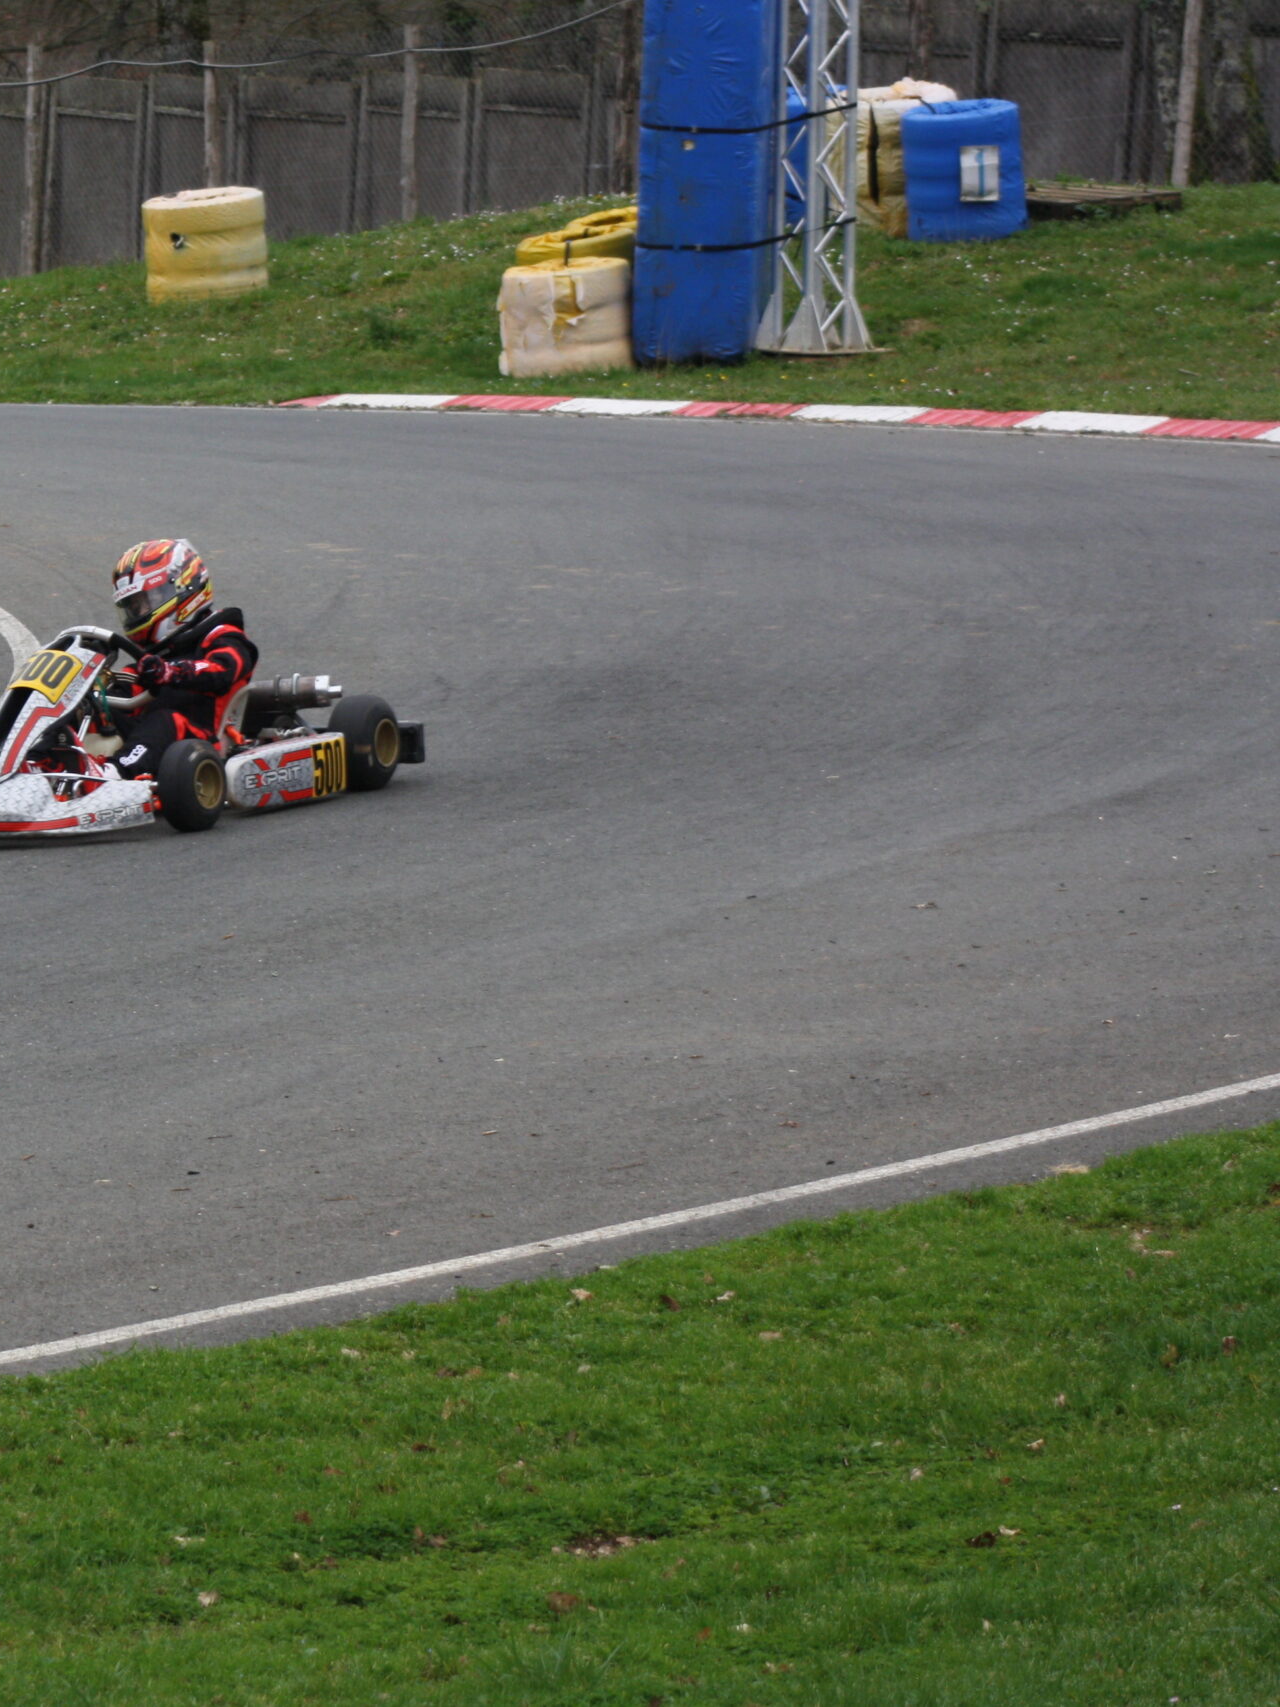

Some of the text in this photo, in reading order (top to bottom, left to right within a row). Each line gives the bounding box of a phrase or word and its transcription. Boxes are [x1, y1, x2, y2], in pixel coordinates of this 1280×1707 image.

[244, 765, 301, 789] EXPRIT
[312, 740, 342, 797] 500
[79, 804, 141, 825] EXPRIT
